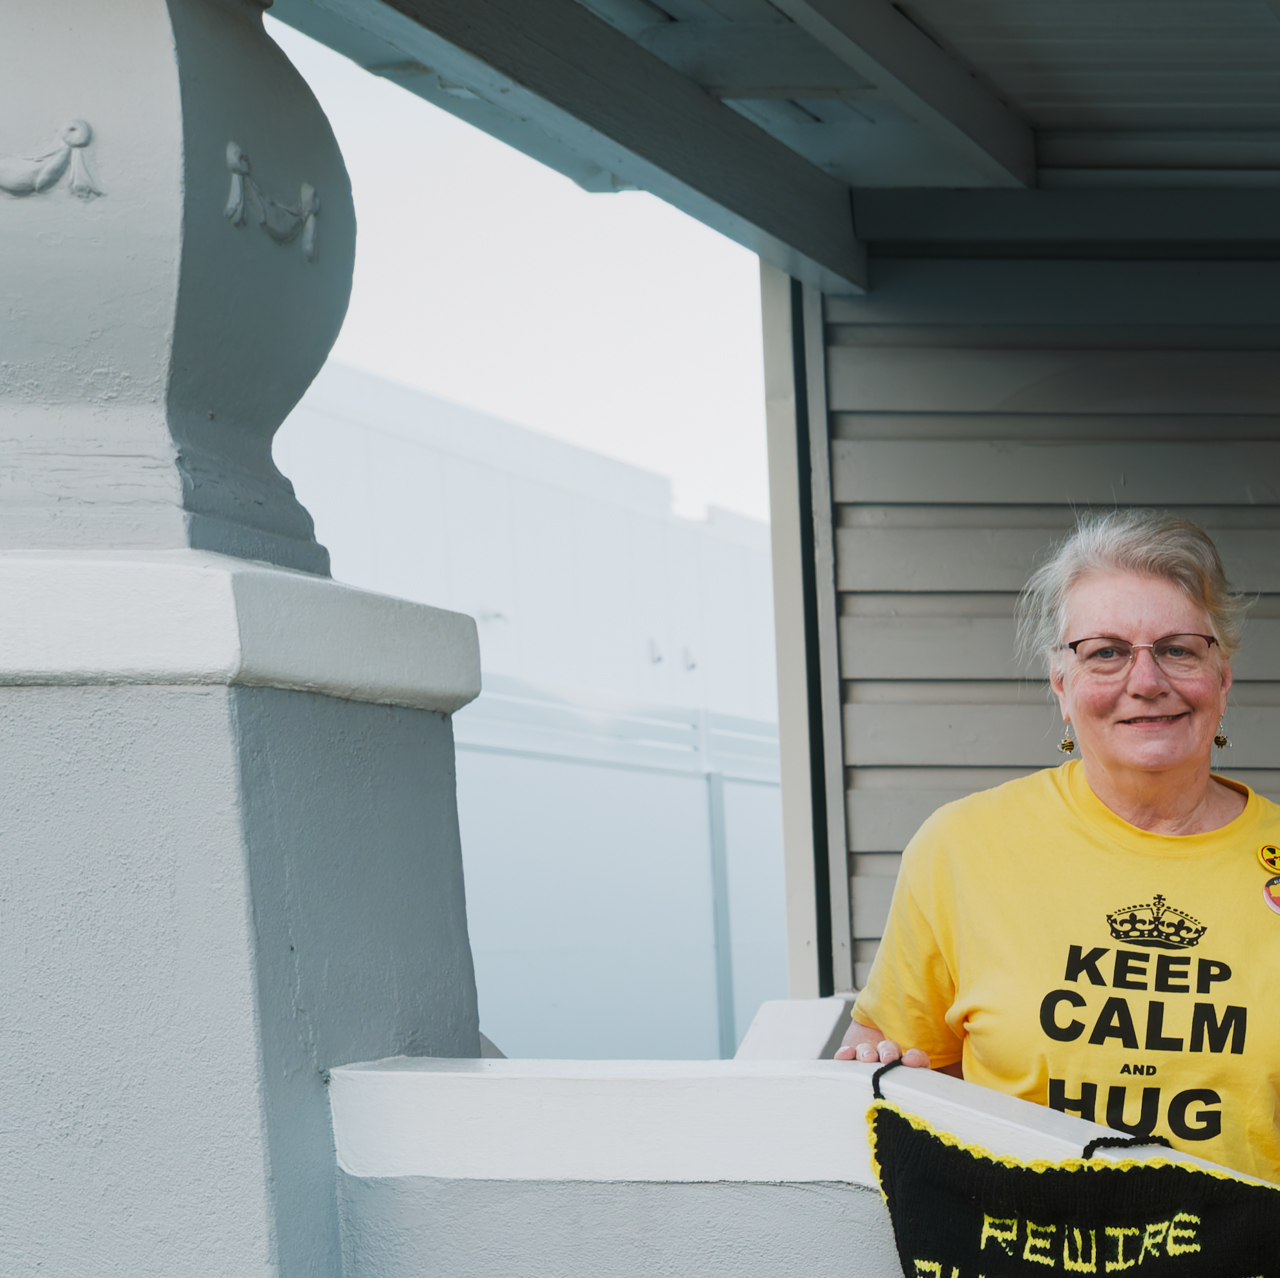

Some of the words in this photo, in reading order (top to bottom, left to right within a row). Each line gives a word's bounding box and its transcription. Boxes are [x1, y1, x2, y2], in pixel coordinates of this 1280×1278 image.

[1065, 945, 1232, 993] KEEP
[1040, 990, 1247, 1054] CALM
[1120, 1064, 1157, 1076] AND
[1048, 1079, 1222, 1141] HUG
[980, 1212, 1201, 1274] REWIRE
